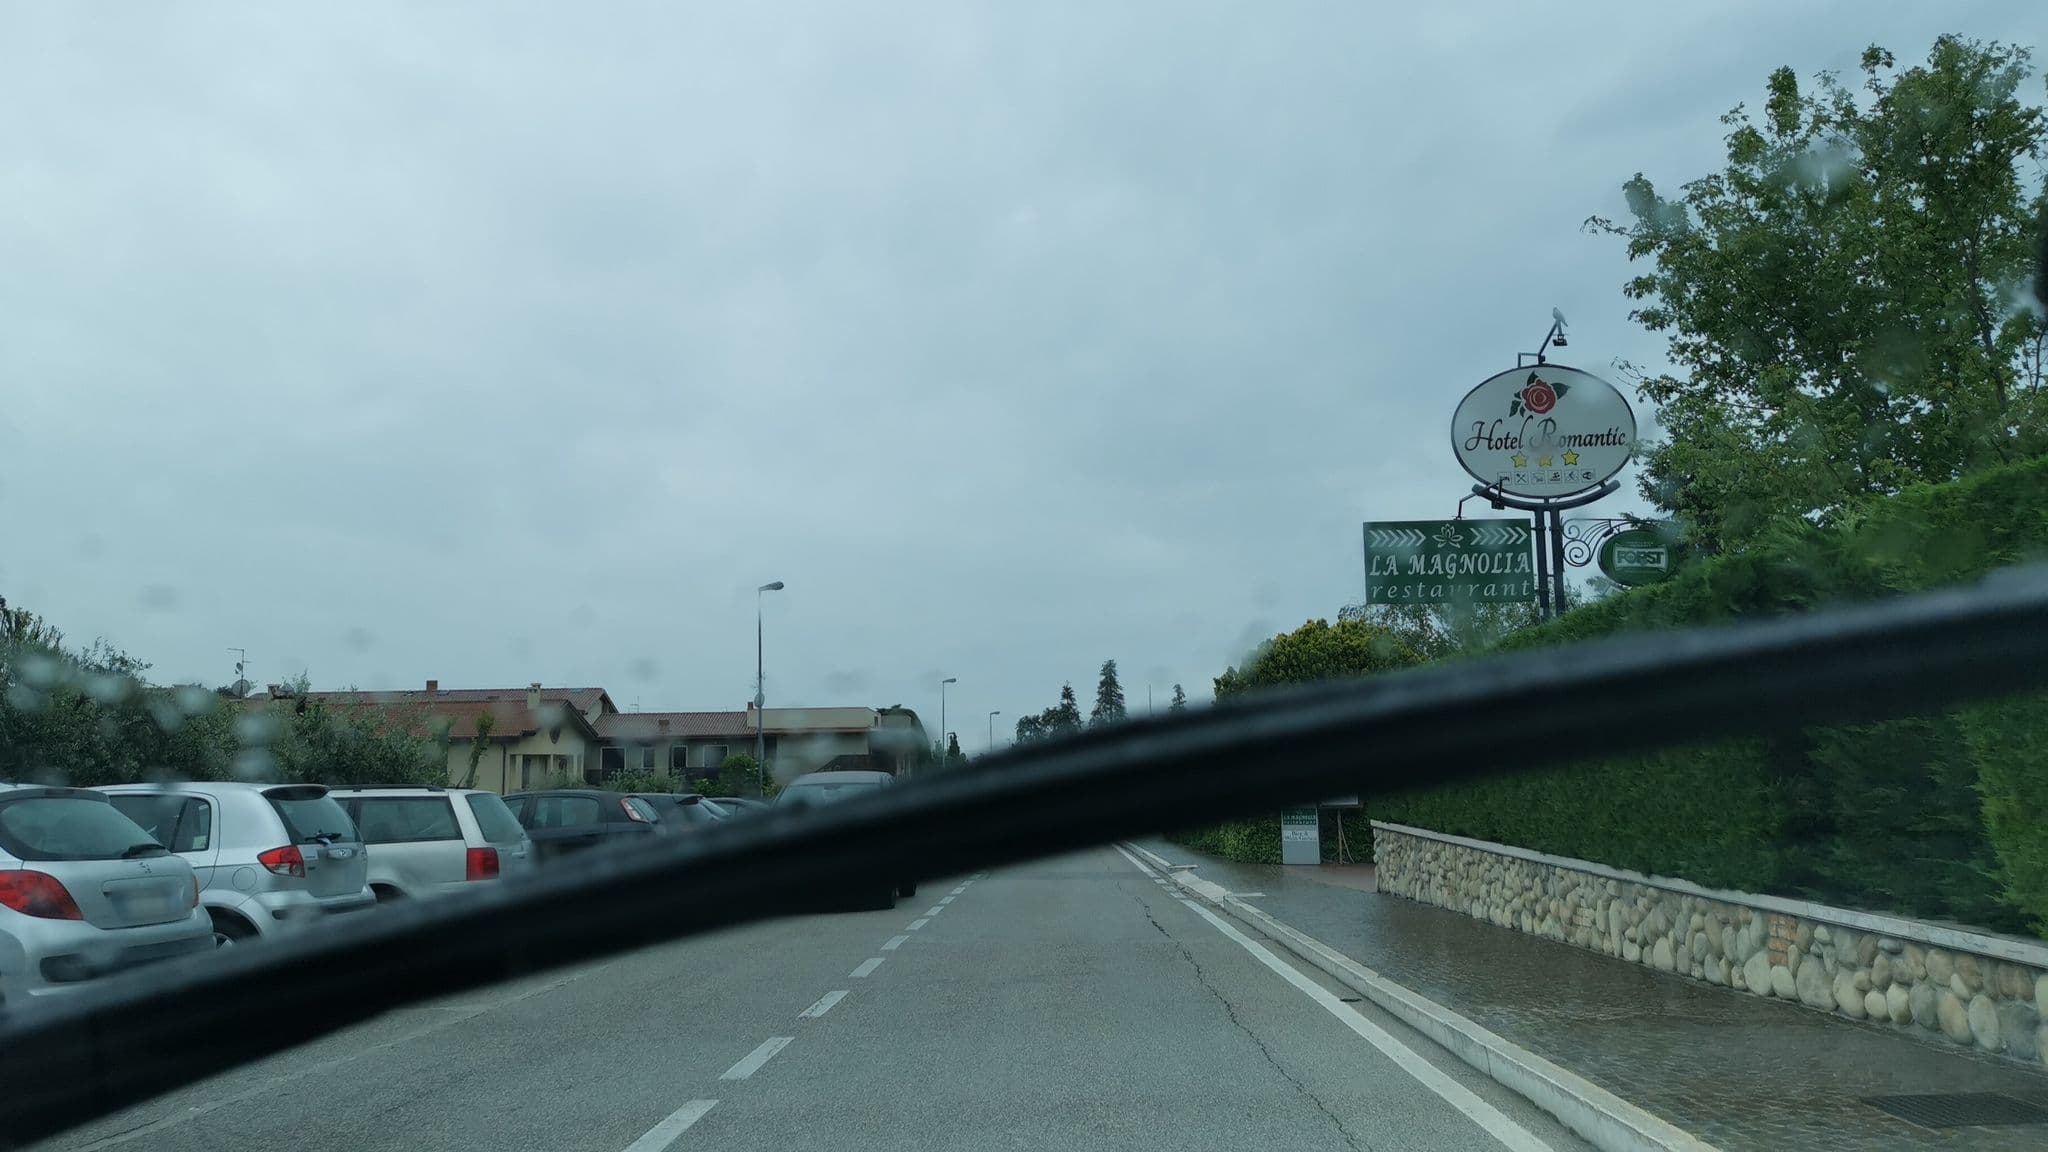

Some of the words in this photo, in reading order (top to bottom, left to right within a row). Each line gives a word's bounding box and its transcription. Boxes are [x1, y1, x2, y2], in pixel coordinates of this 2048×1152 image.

[1465, 415, 1533, 451] Hotel
[1529, 417, 1626, 450] Romantic
[1369, 554, 1399, 576] LA
[1407, 551, 1531, 579] MAGNOLIA
[1371, 579, 1531, 598] restaurant
